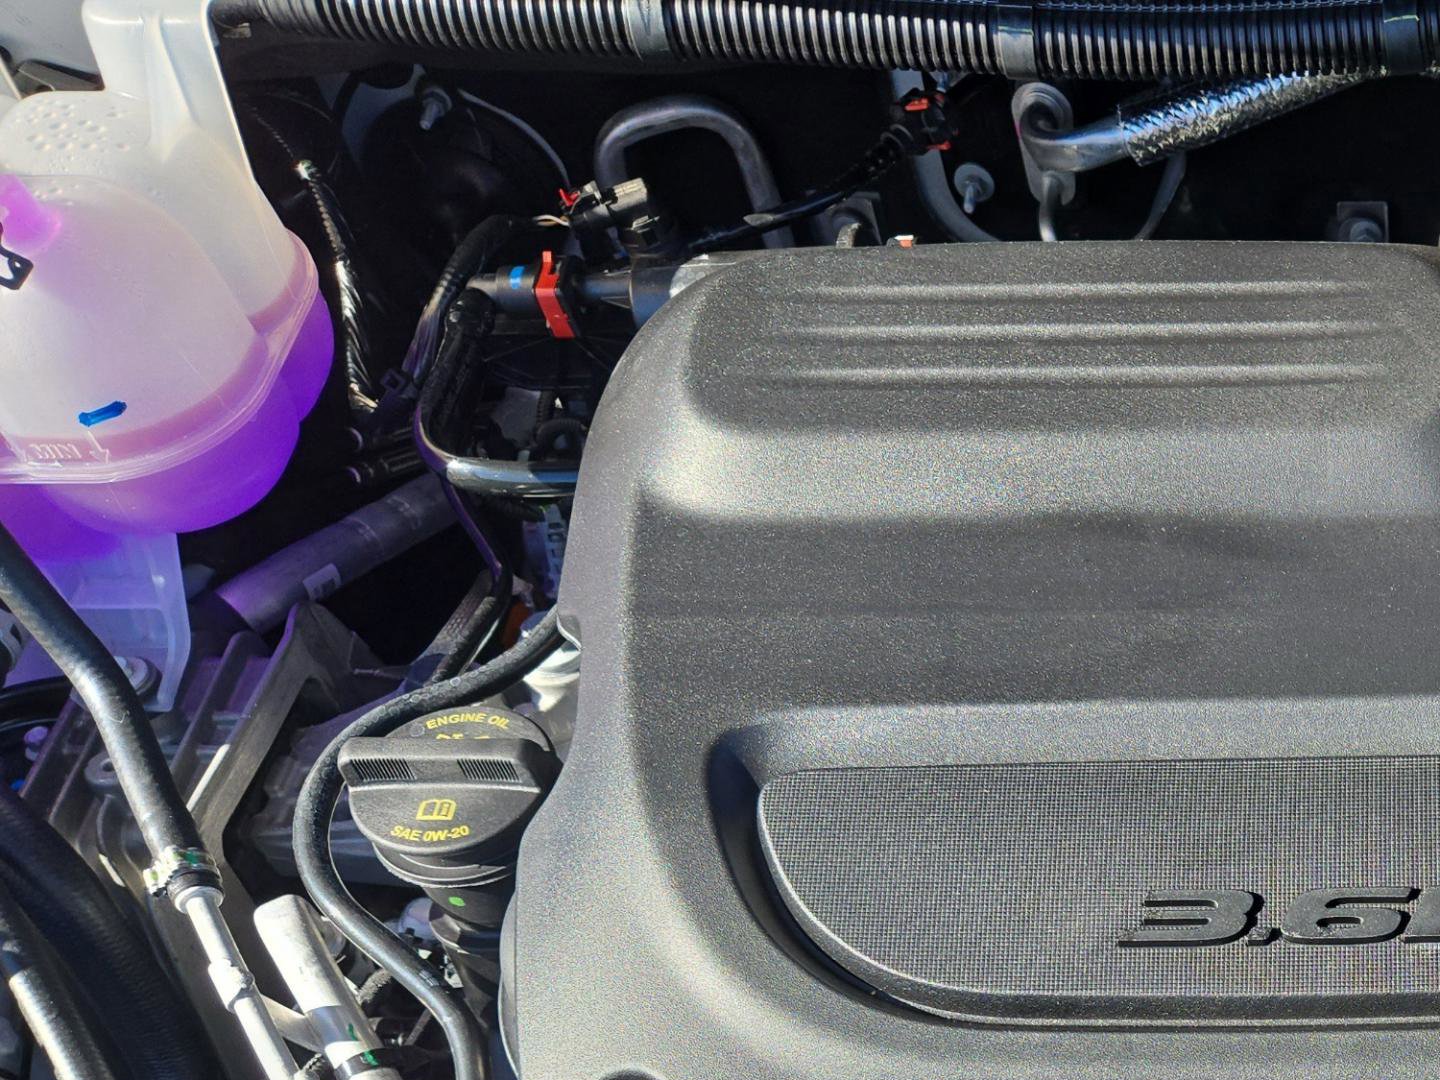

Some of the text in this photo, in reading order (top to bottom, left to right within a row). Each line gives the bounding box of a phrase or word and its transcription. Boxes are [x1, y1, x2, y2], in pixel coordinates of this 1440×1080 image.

[425, 712, 511, 730] ENGINE OIL
[390, 825, 470, 842] SAE 0W-20
